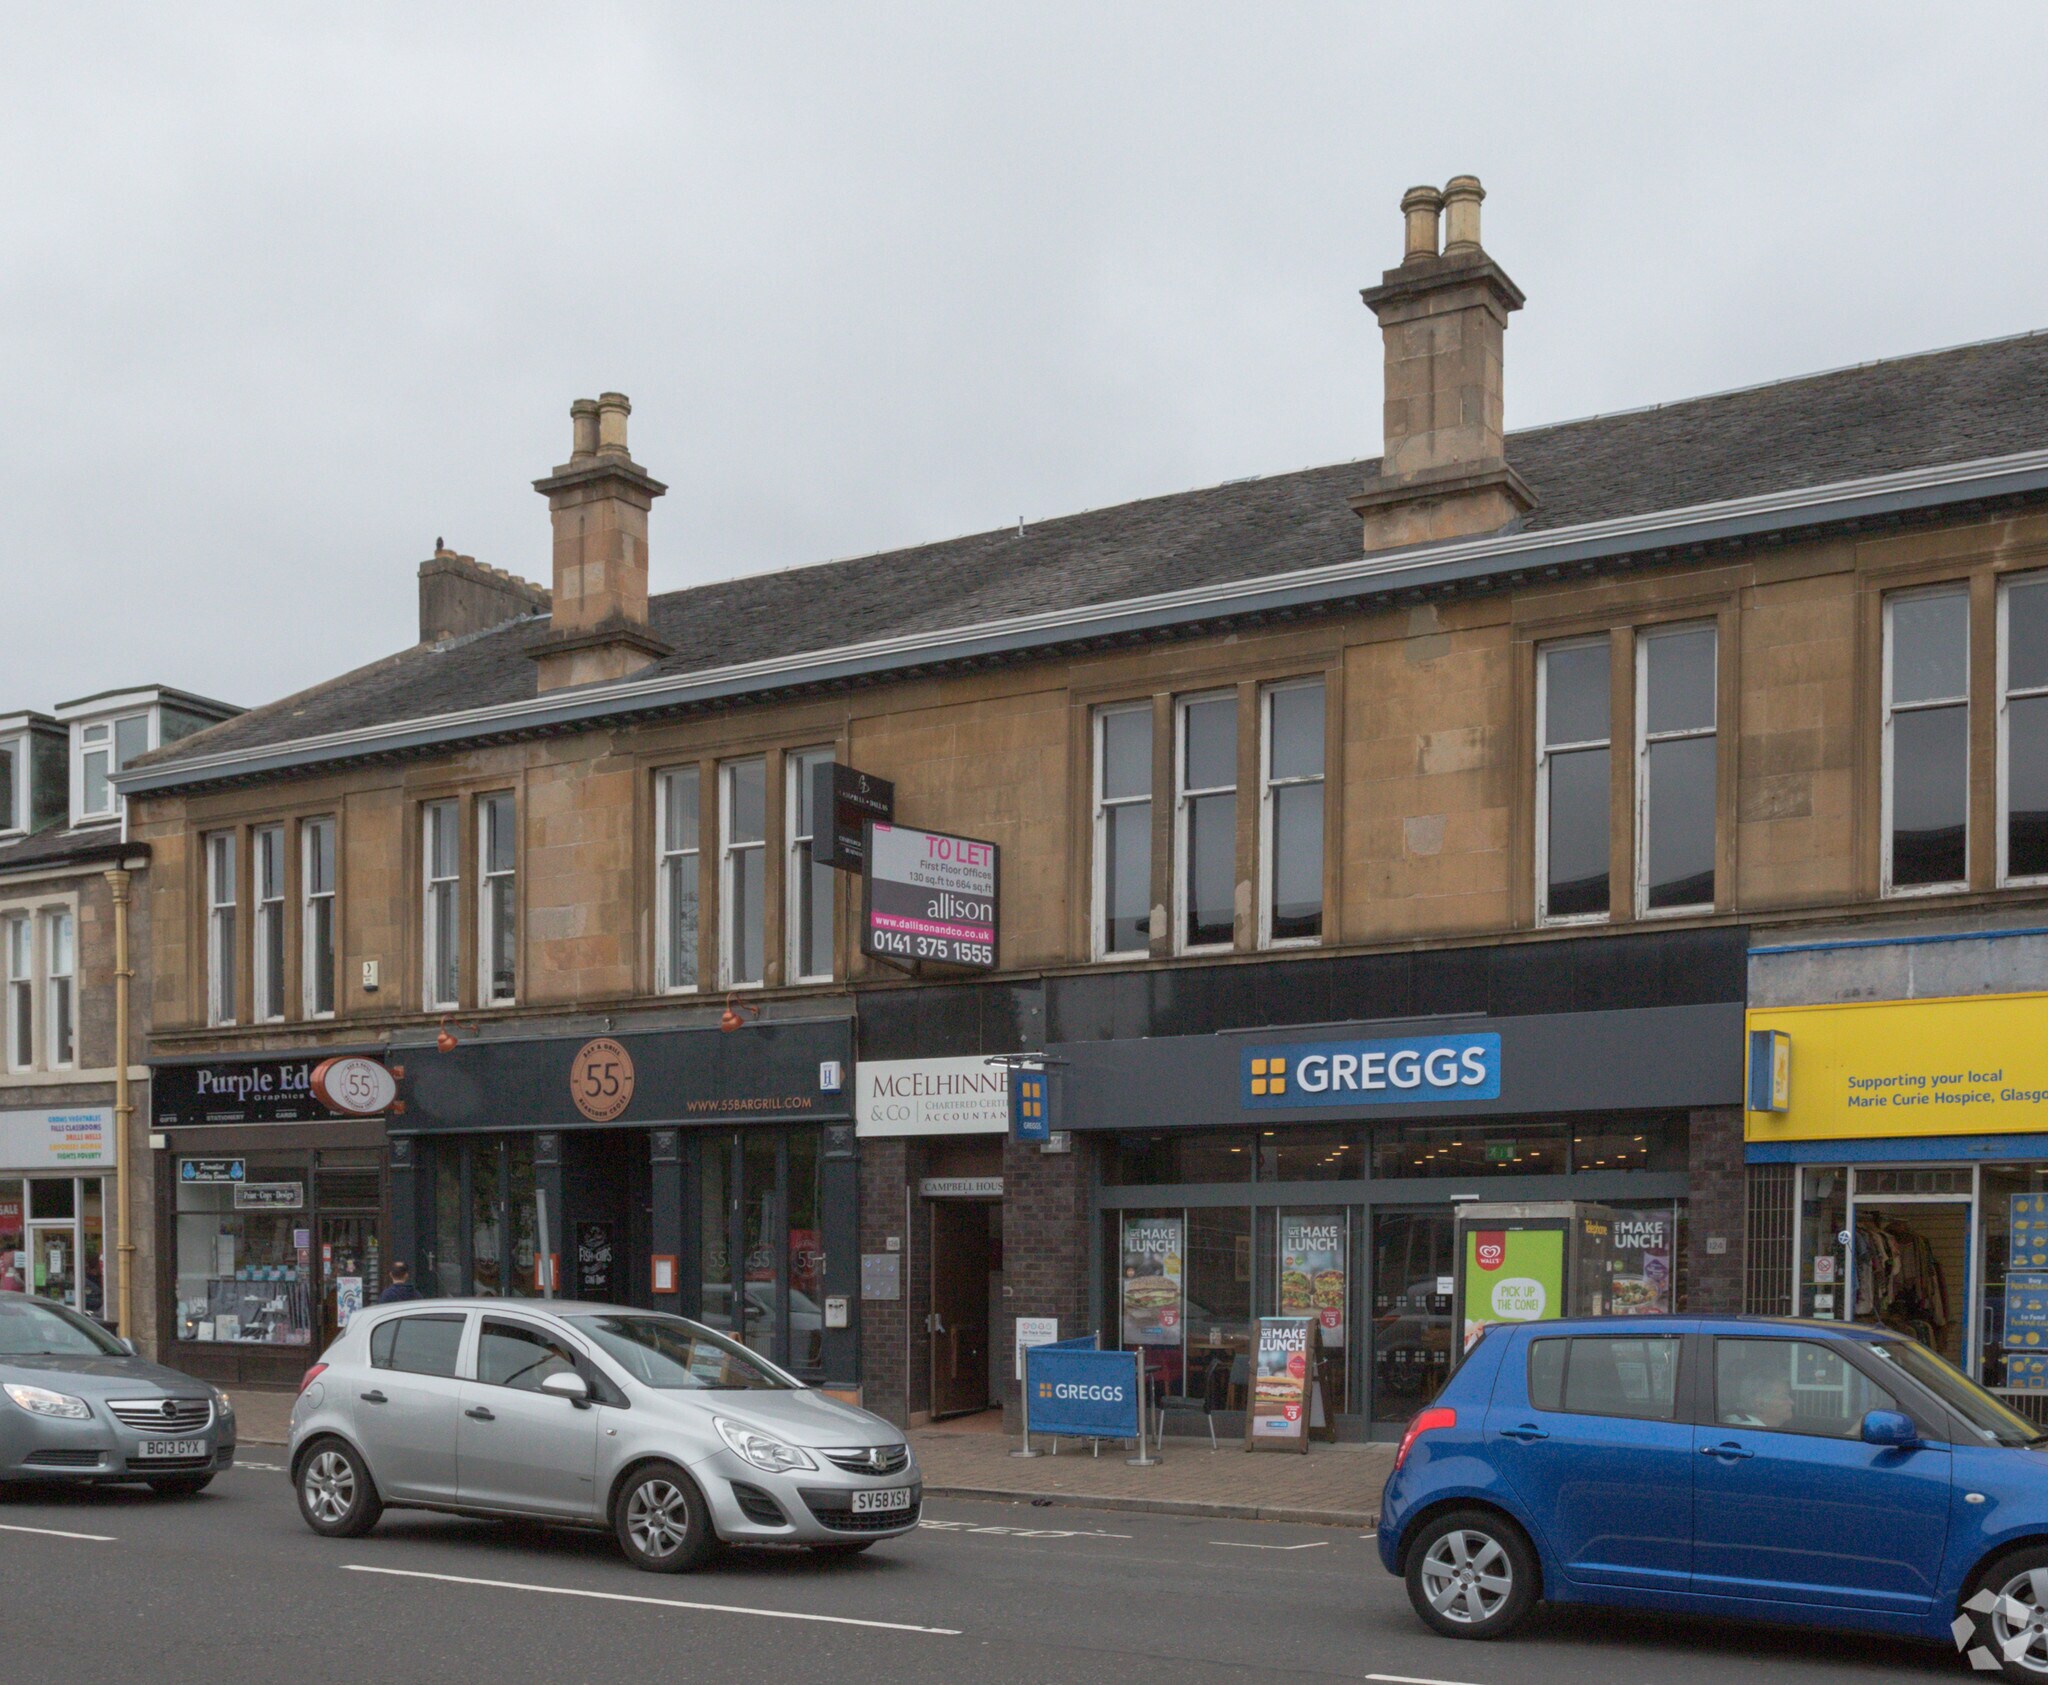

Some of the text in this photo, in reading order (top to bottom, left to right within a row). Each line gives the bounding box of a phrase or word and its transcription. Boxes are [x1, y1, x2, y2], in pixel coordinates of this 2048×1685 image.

[925, 836, 992, 866] TO LET
[920, 860, 992, 880] First Floor Offices
[909, 872, 924, 882] 130
[925, 875, 944, 886] sq.ft
[946, 878, 955, 887] to
[972, 883, 992, 893] sq.ft
[927, 892, 992, 922] allison
[875, 916, 989, 941] www.dallisonandco.co.uk
[874, 930, 992, 964] 0141 375 1555
[1296, 1046, 1486, 1092] GREGGS
[197, 1064, 314, 1101] Purple Ed
[349, 1074, 370, 1097] 55
[585, 1063, 619, 1097] 55
[1848, 1069, 2002, 1090] Supporting your local
[254, 1093, 305, 1101] Graphics
[687, 1097, 812, 1112] WWW.55BARGRILL.COM
[925, 1100, 977, 1110] CHARTERED
[1848, 1094, 1887, 1107] Marie
[1893, 1092, 1929, 1106] Curie
[1934, 1090, 1995, 1106] Hospice,
[871, 1104, 883, 1121] &
[925, 1112, 1007, 1121] ACCOUNTAN
[1023, 1121, 1042, 1130] GREGGS
[925, 1182, 974, 1191] CAMPBELL
[1141, 1229, 1176, 1239] MAKE
[1300, 1226, 1338, 1238] MAKE
[1621, 1222, 1663, 1233] MAKE
[1130, 1240, 1176, 1252] LUNCH
[1288, 1238, 1338, 1251] LUNCH
[753, 1251, 770, 1268] 55
[1501, 1286, 1535, 1297] PICK UP
[1497, 1299, 1538, 1312] THE CONE!
[1272, 1328, 1306, 1339] MAKE
[1260, 1339, 1305, 1352] LUNCH
[1055, 1383, 1123, 1401] GREGGS
[147, 1441, 199, 1454] BG13 GYX
[858, 1489, 907, 1509] SV58 XSX
